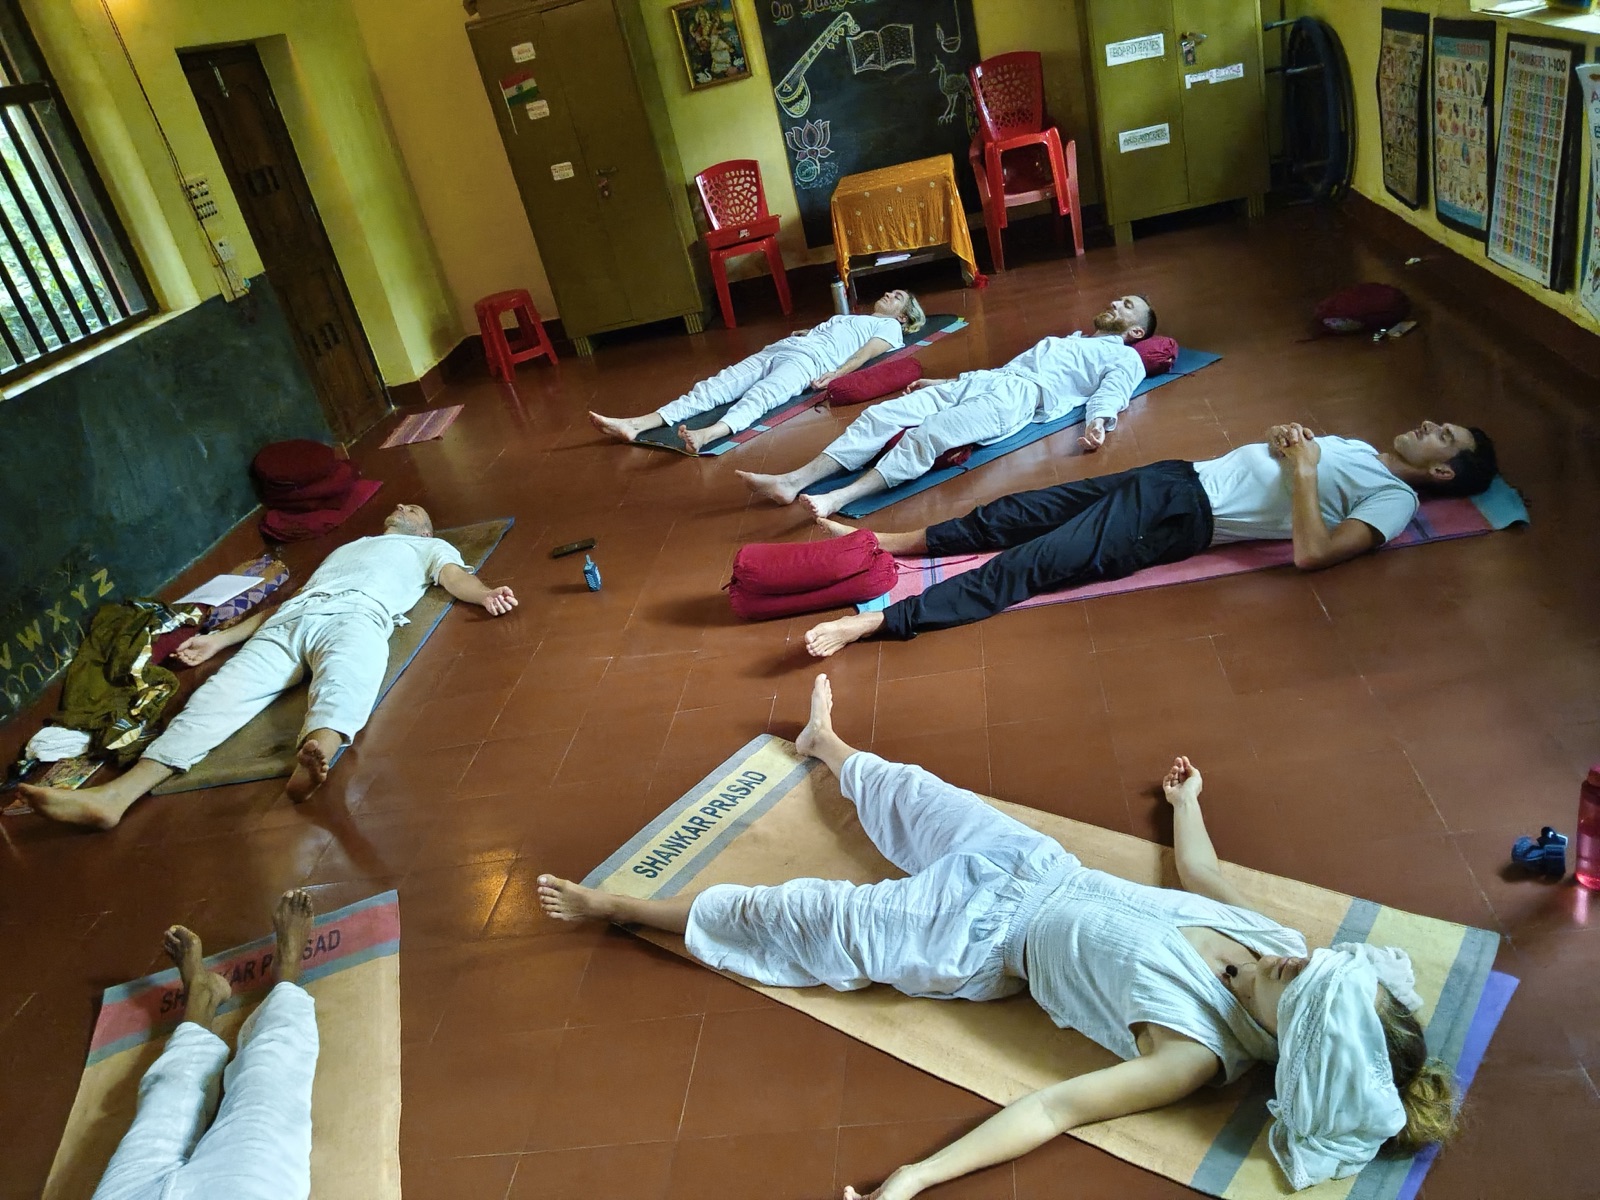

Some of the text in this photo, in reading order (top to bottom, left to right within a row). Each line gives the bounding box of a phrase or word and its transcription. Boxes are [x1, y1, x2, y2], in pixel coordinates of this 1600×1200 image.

[771, 1, 794, 19] Om
[16, 618, 43, 652] W
[45, 601, 71, 633] X
[70, 584, 88, 609] Y
[90, 568, 115, 597] Z
[632, 770, 768, 879] SHANKAR PRASAD
